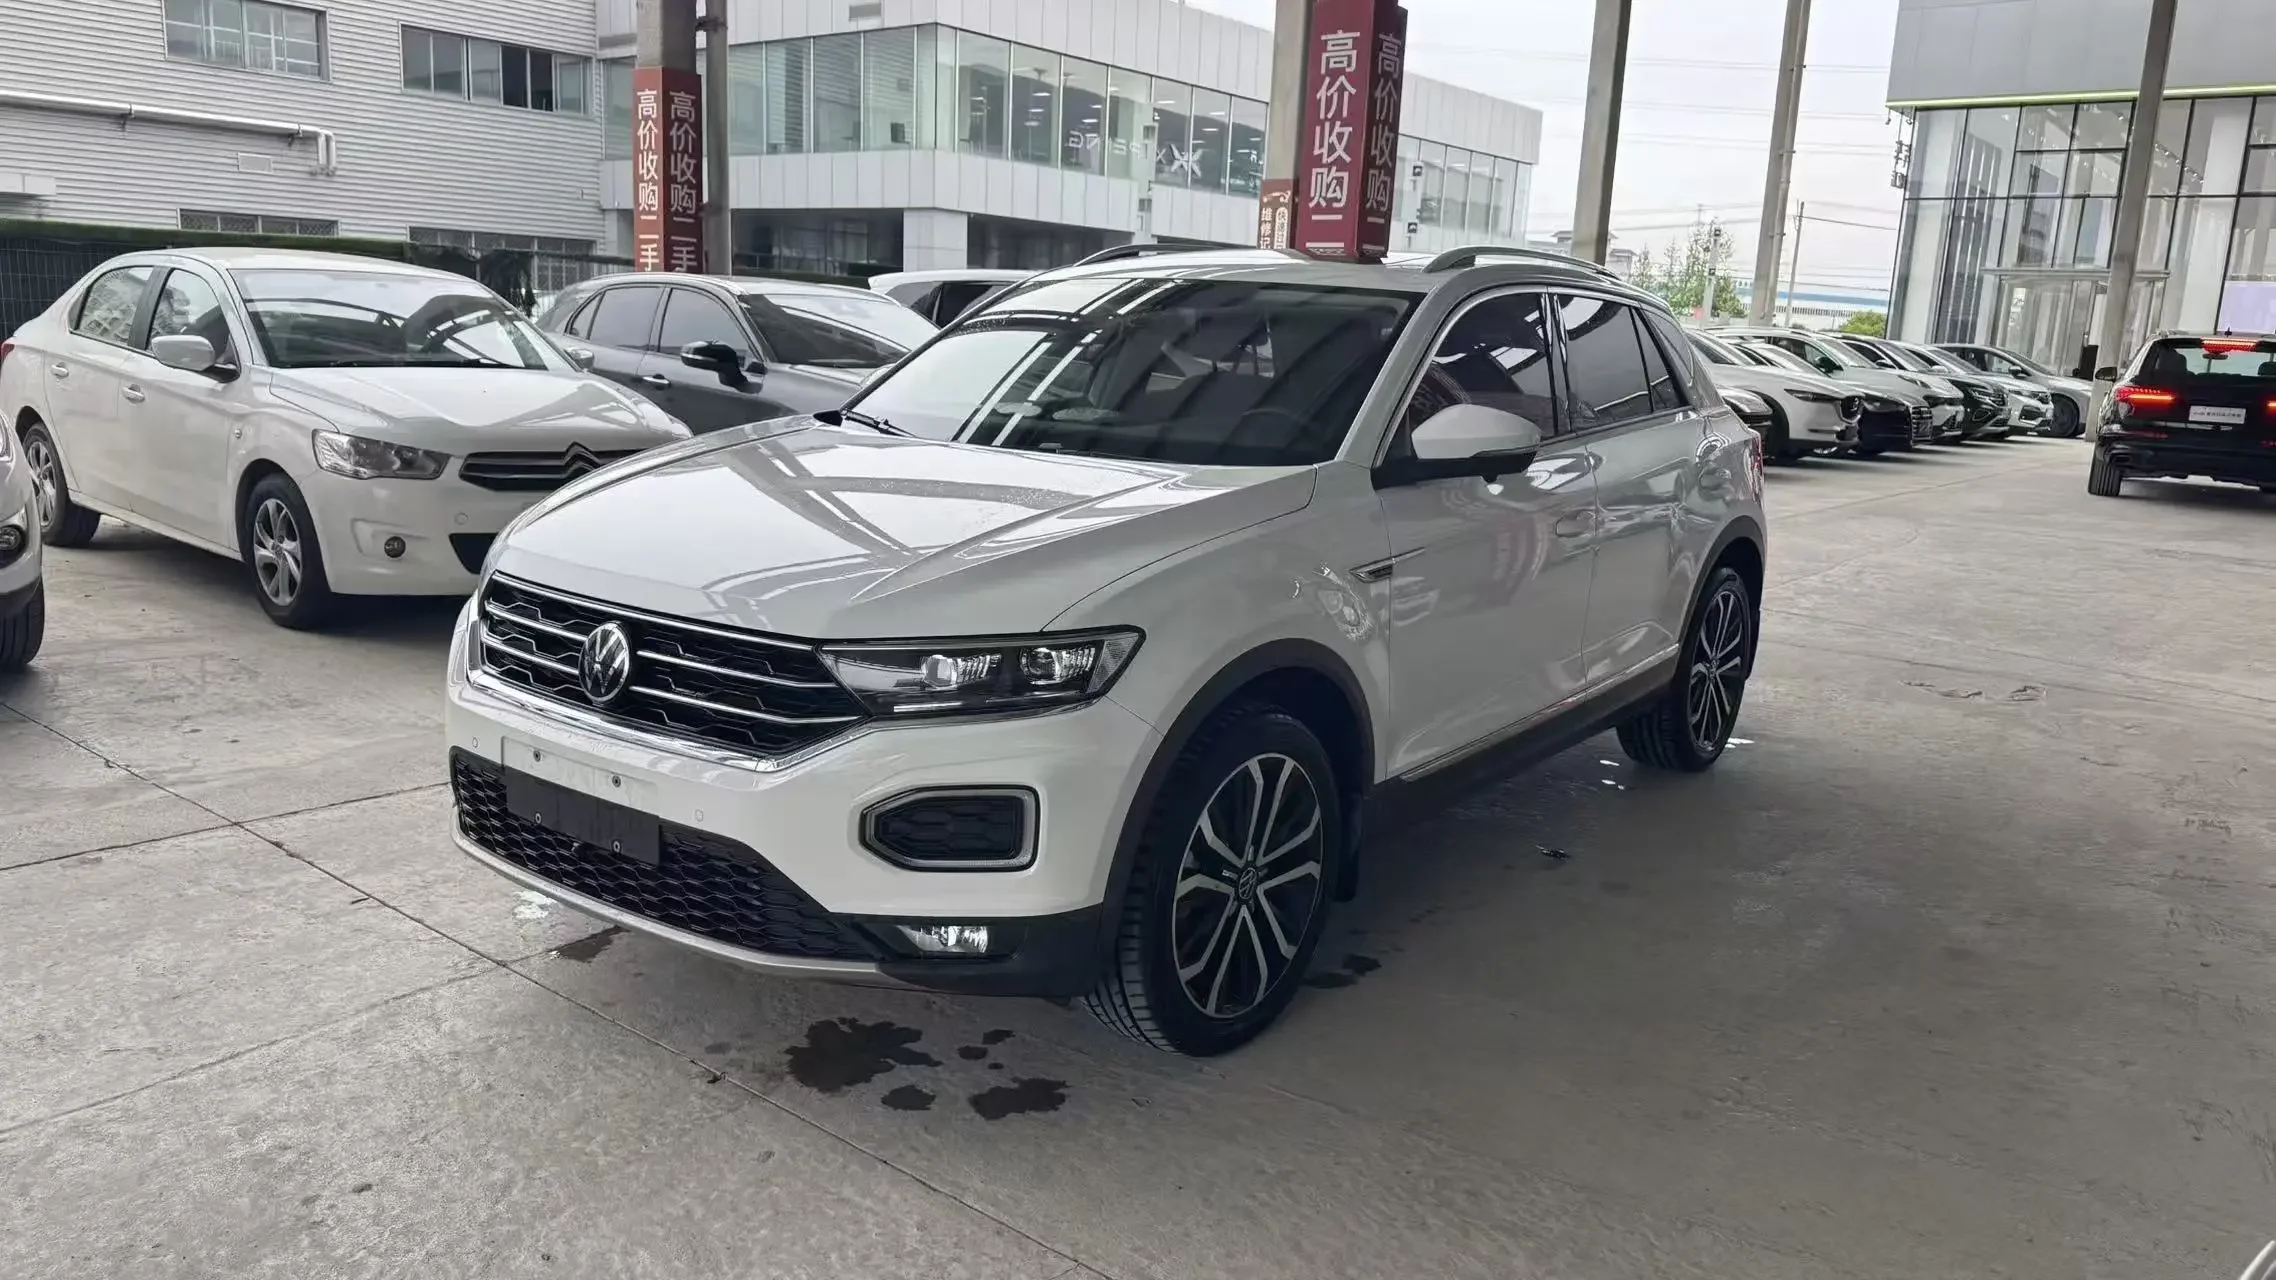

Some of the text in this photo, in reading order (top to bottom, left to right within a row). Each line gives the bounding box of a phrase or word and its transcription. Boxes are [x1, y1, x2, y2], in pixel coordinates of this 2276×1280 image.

[637, 88, 660, 272] 高价收购二手
[669, 91, 698, 272] 高价收购二手
